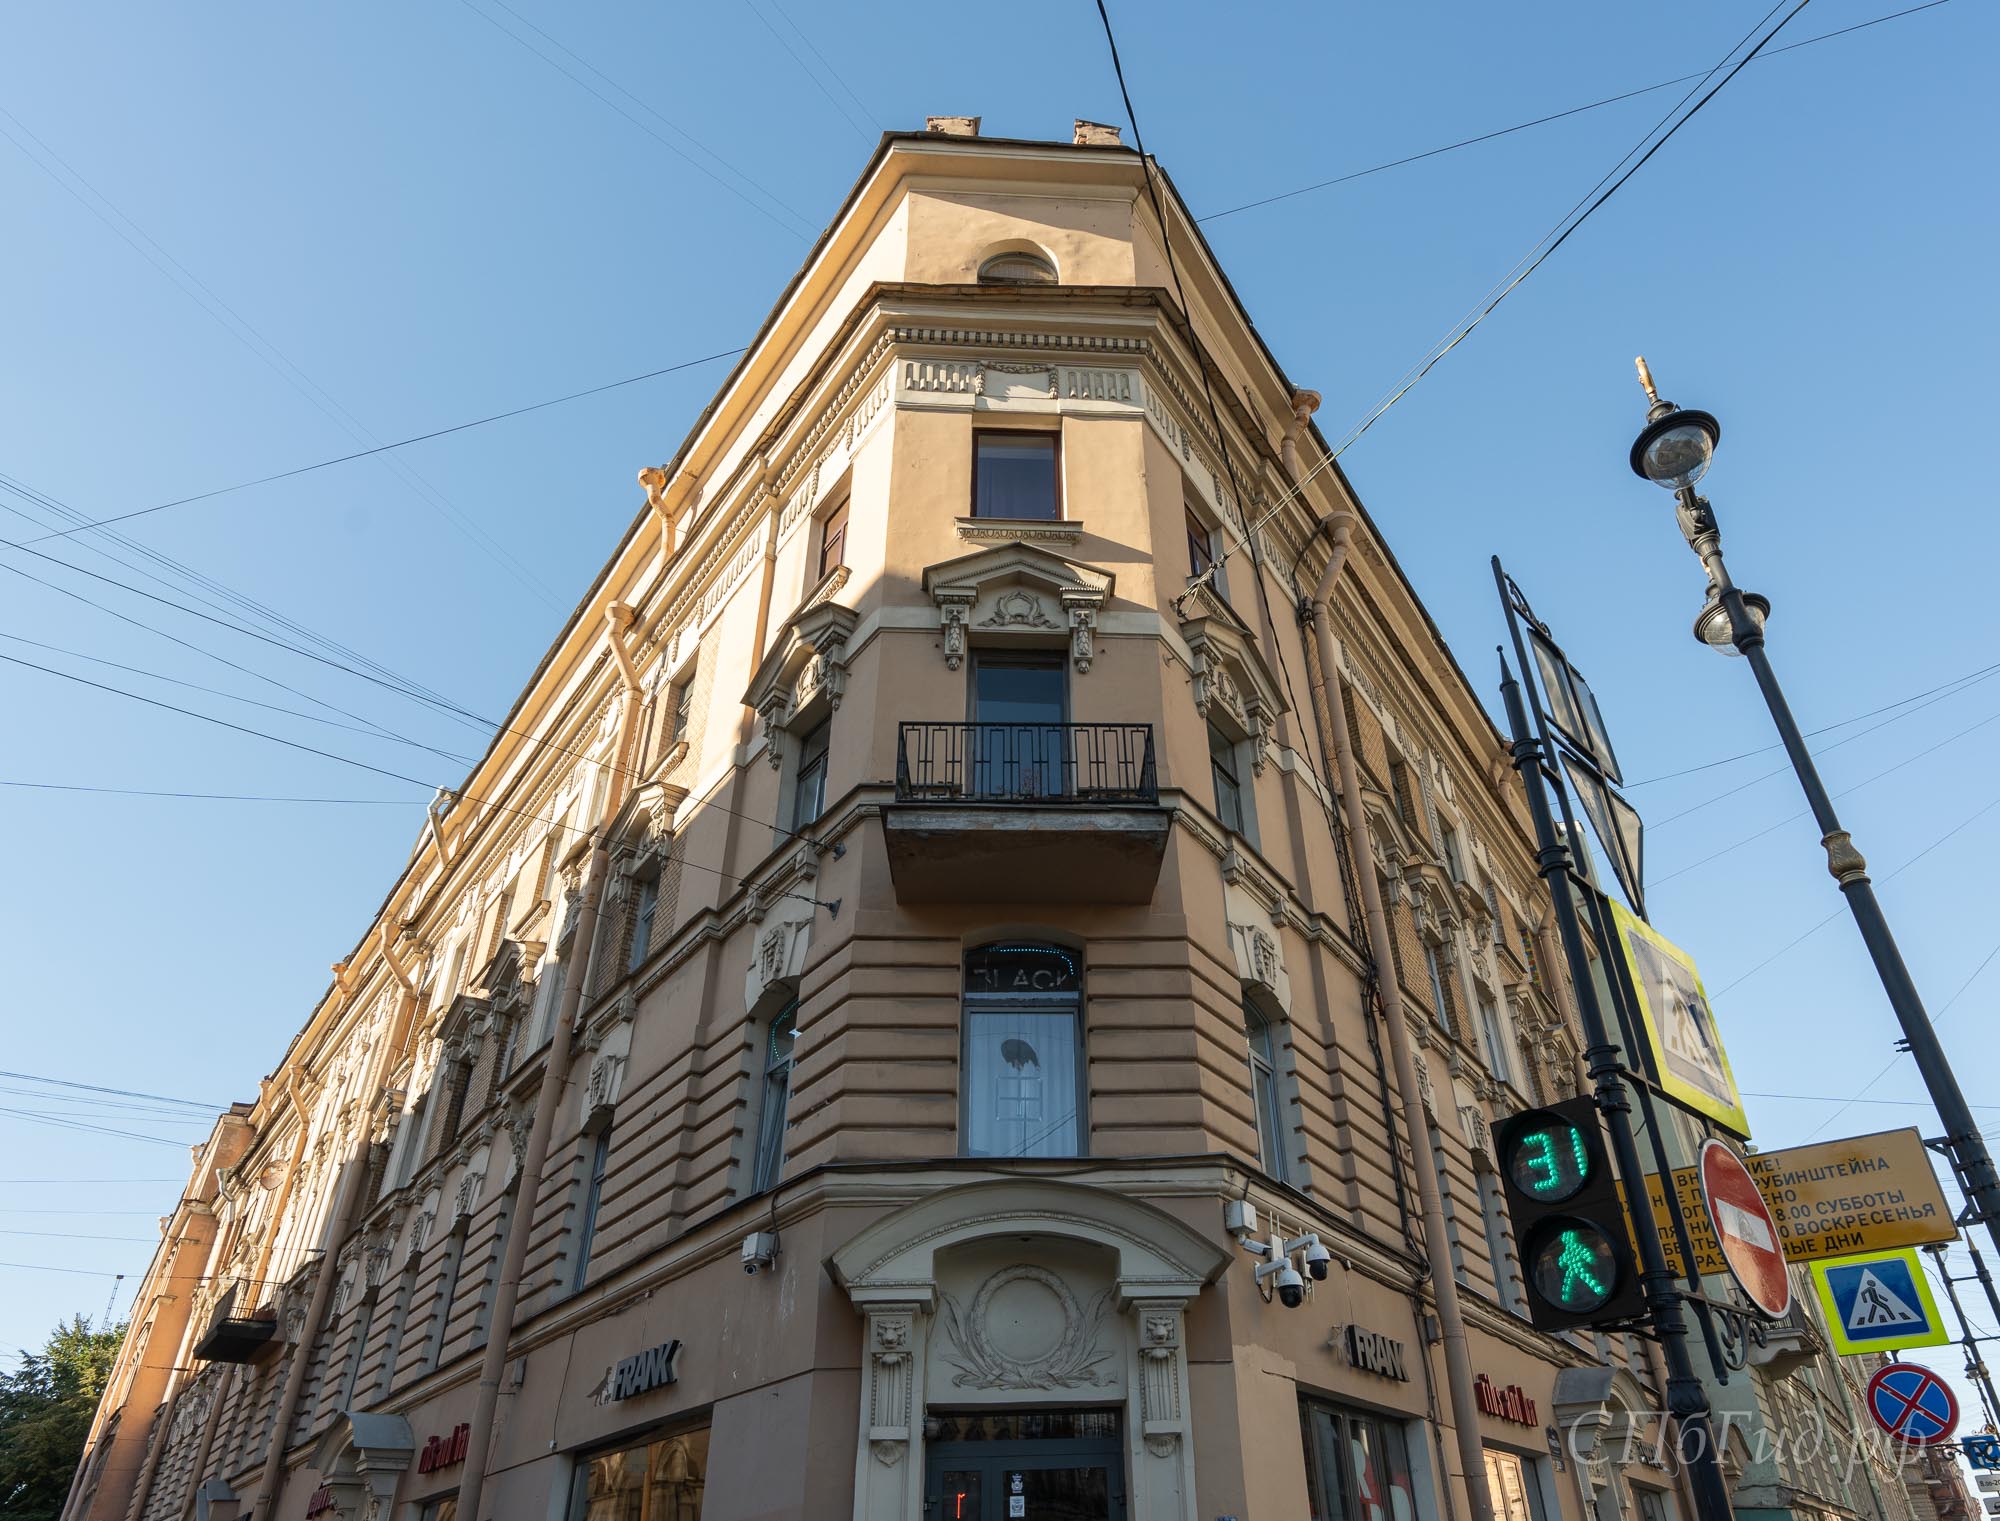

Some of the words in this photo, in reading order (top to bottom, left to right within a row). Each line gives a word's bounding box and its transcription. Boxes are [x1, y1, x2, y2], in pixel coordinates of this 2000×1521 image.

[1523, 1127, 1587, 1191] 31
[1794, 1202, 1936, 1236] ВОСКРЕСЕНЬЯ
[1816, 1190, 1905, 1216] СУББОТЫ
[1824, 1232, 1865, 1252] ДНИ
[611, 1339, 681, 1401] FRANK
[1347, 1324, 1410, 1382] FRANK
